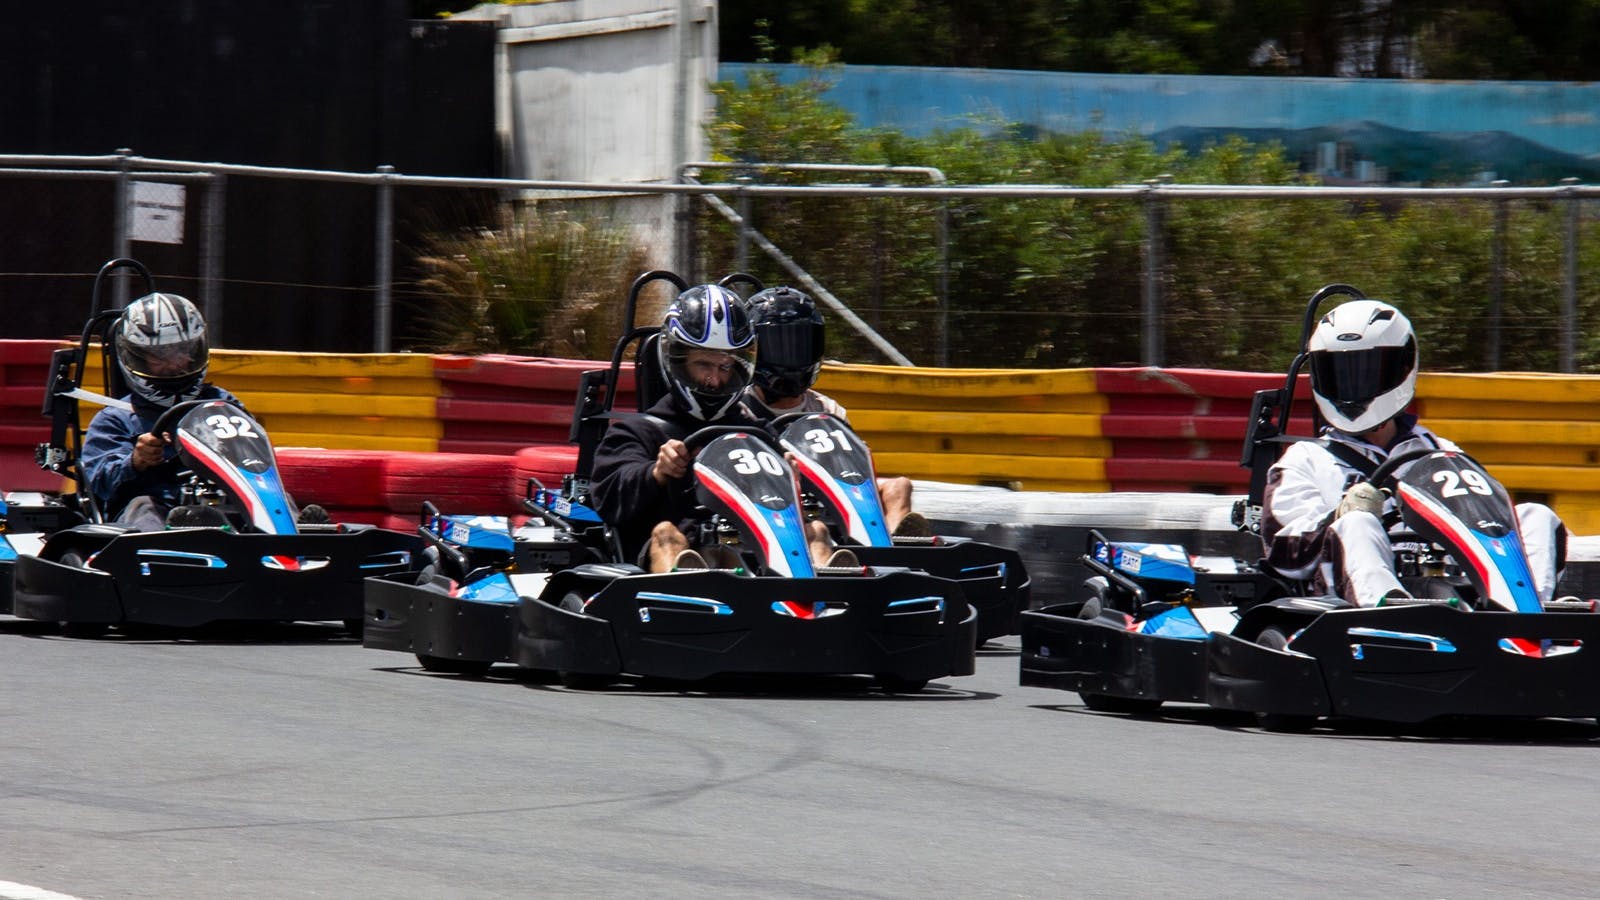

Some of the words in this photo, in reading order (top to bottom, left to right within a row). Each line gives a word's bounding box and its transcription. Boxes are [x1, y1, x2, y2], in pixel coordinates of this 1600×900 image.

[205, 414, 259, 439] 32
[804, 428, 853, 453] 31
[728, 448, 784, 476] 30
[1432, 469, 1493, 498] 29
